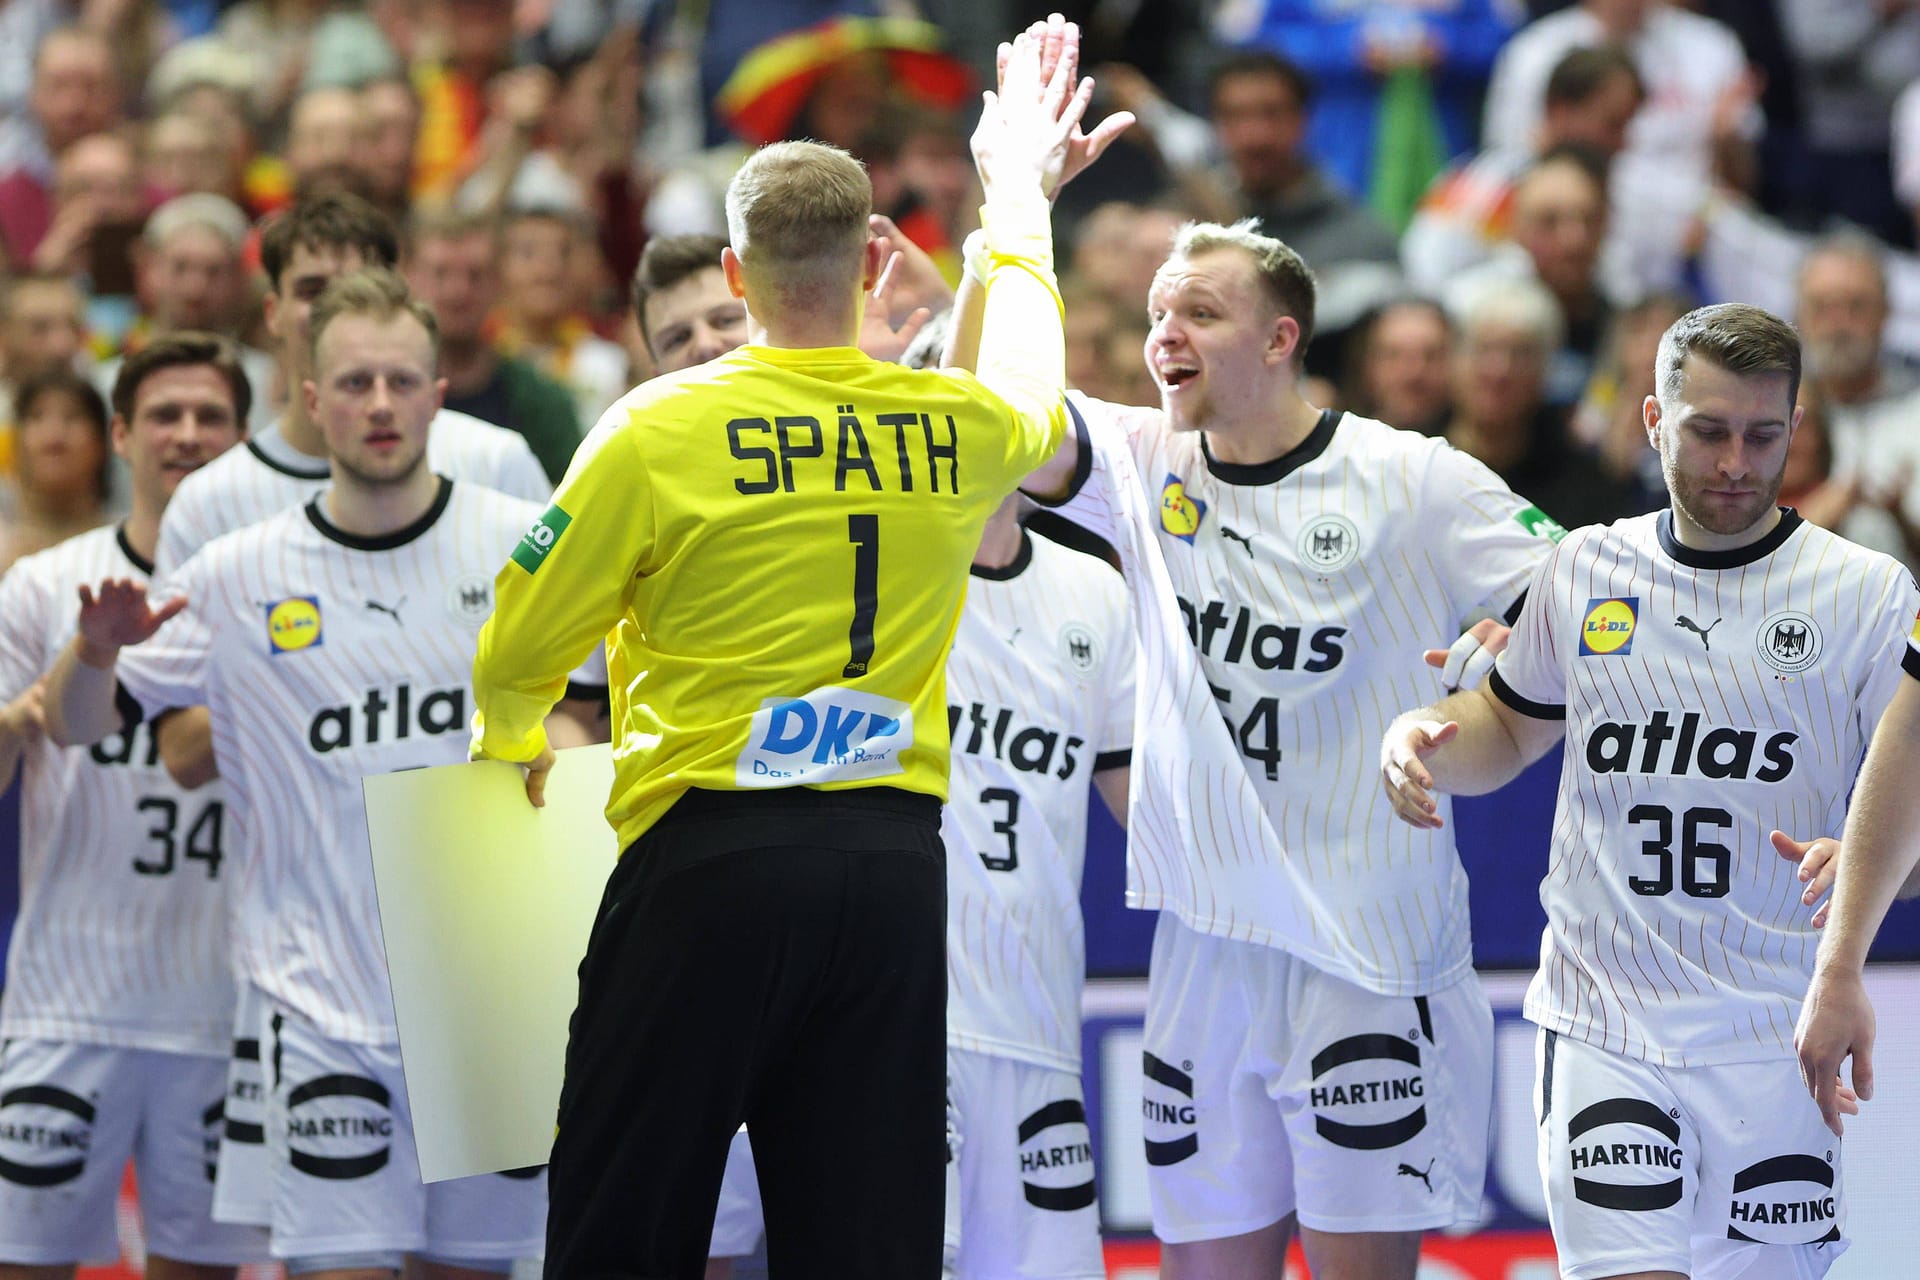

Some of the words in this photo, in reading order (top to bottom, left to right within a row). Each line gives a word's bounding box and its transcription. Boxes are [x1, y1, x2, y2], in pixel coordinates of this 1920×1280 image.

[726, 404, 959, 495] SPÄTH
[842, 514, 879, 679] 1
[1586, 711, 1800, 782] atlas
[133, 797, 224, 878] 34
[979, 787, 1020, 872] 3
[1628, 804, 1733, 898] 36
[1311, 1075, 1424, 1107] HARTING
[0, 1124, 91, 1152] ARTING
[288, 1117, 393, 1137] HARTING
[1570, 1144, 1683, 1170] HARTING
[1730, 1196, 1835, 1224] HARTING
